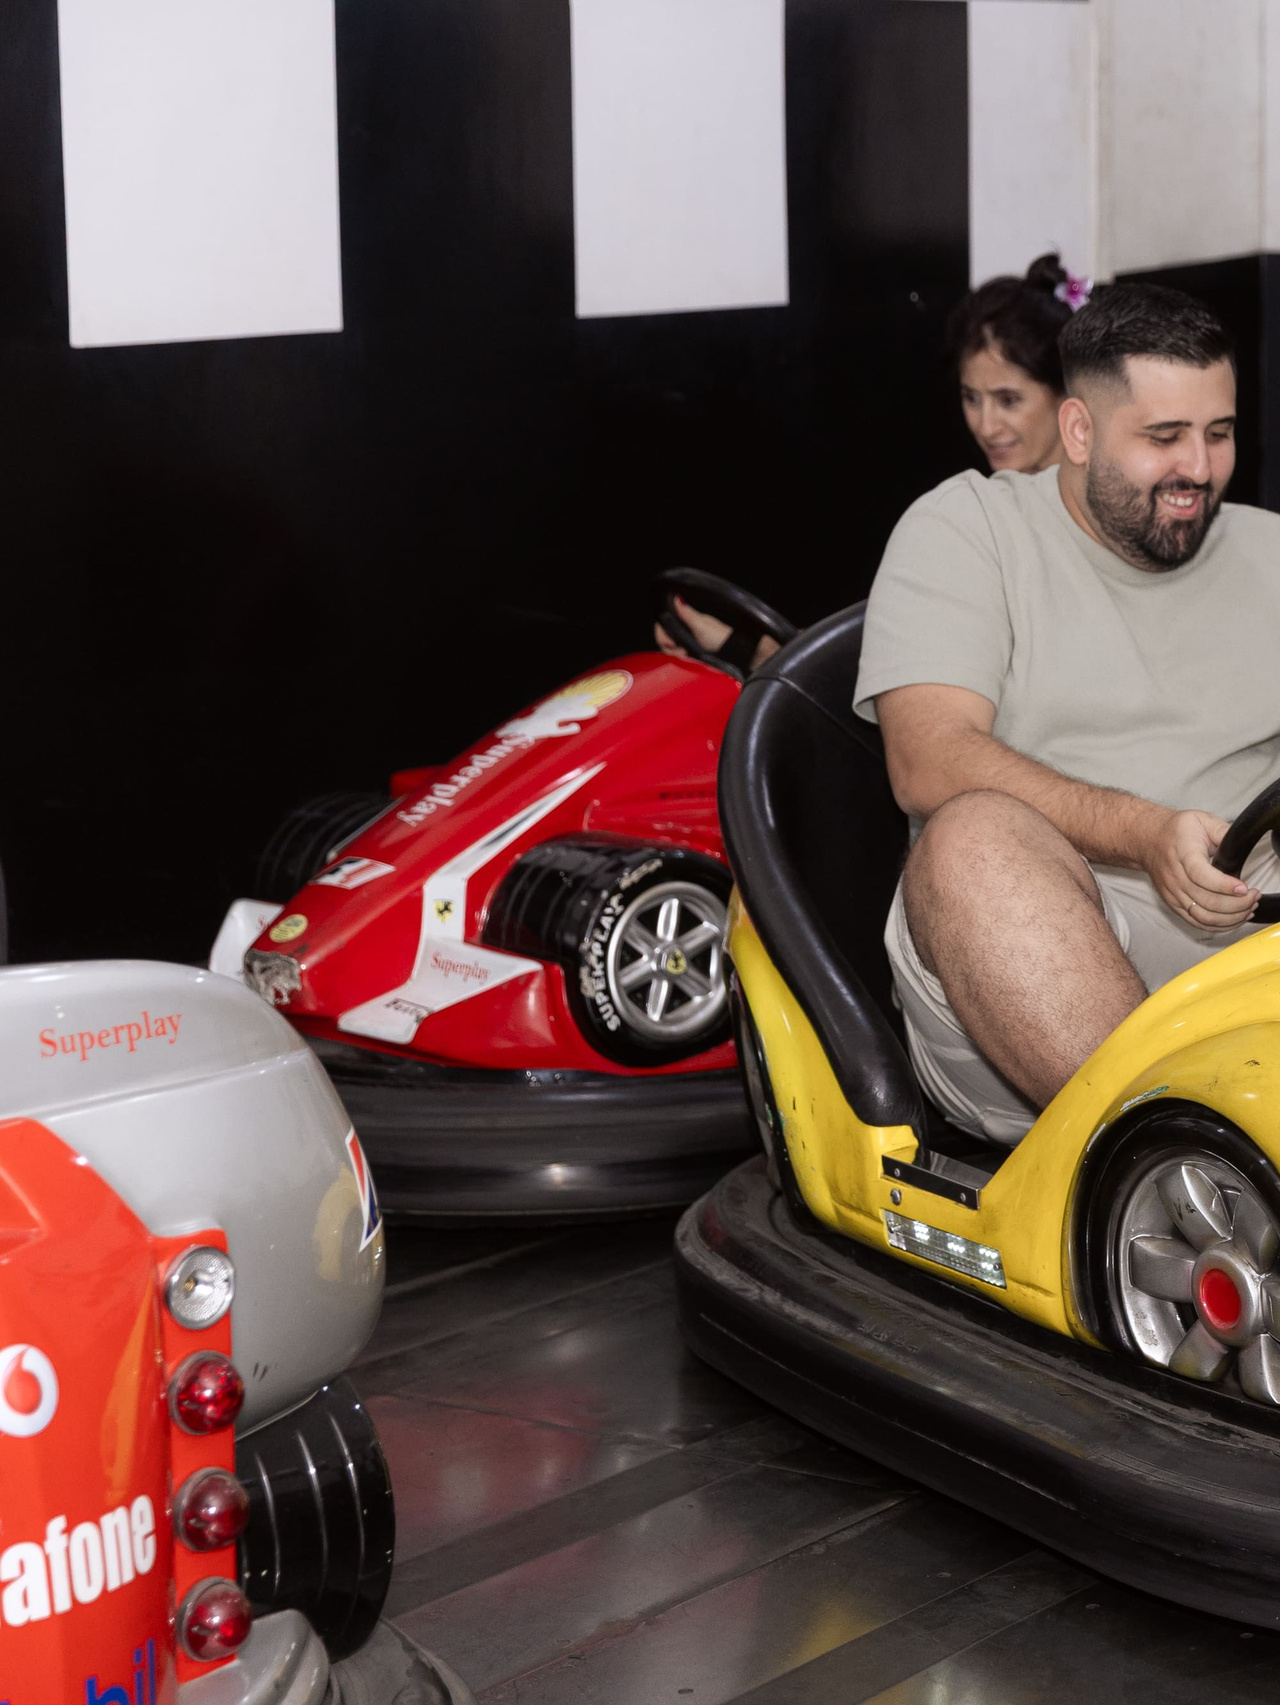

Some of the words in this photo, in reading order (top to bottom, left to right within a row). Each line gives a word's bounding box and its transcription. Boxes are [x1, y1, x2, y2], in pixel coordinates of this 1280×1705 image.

[396, 733, 536, 828] Superplay
[430, 951, 490, 985] Superplay
[38, 1011, 183, 1061] Superplay
[0, 1494, 156, 1627] afone
